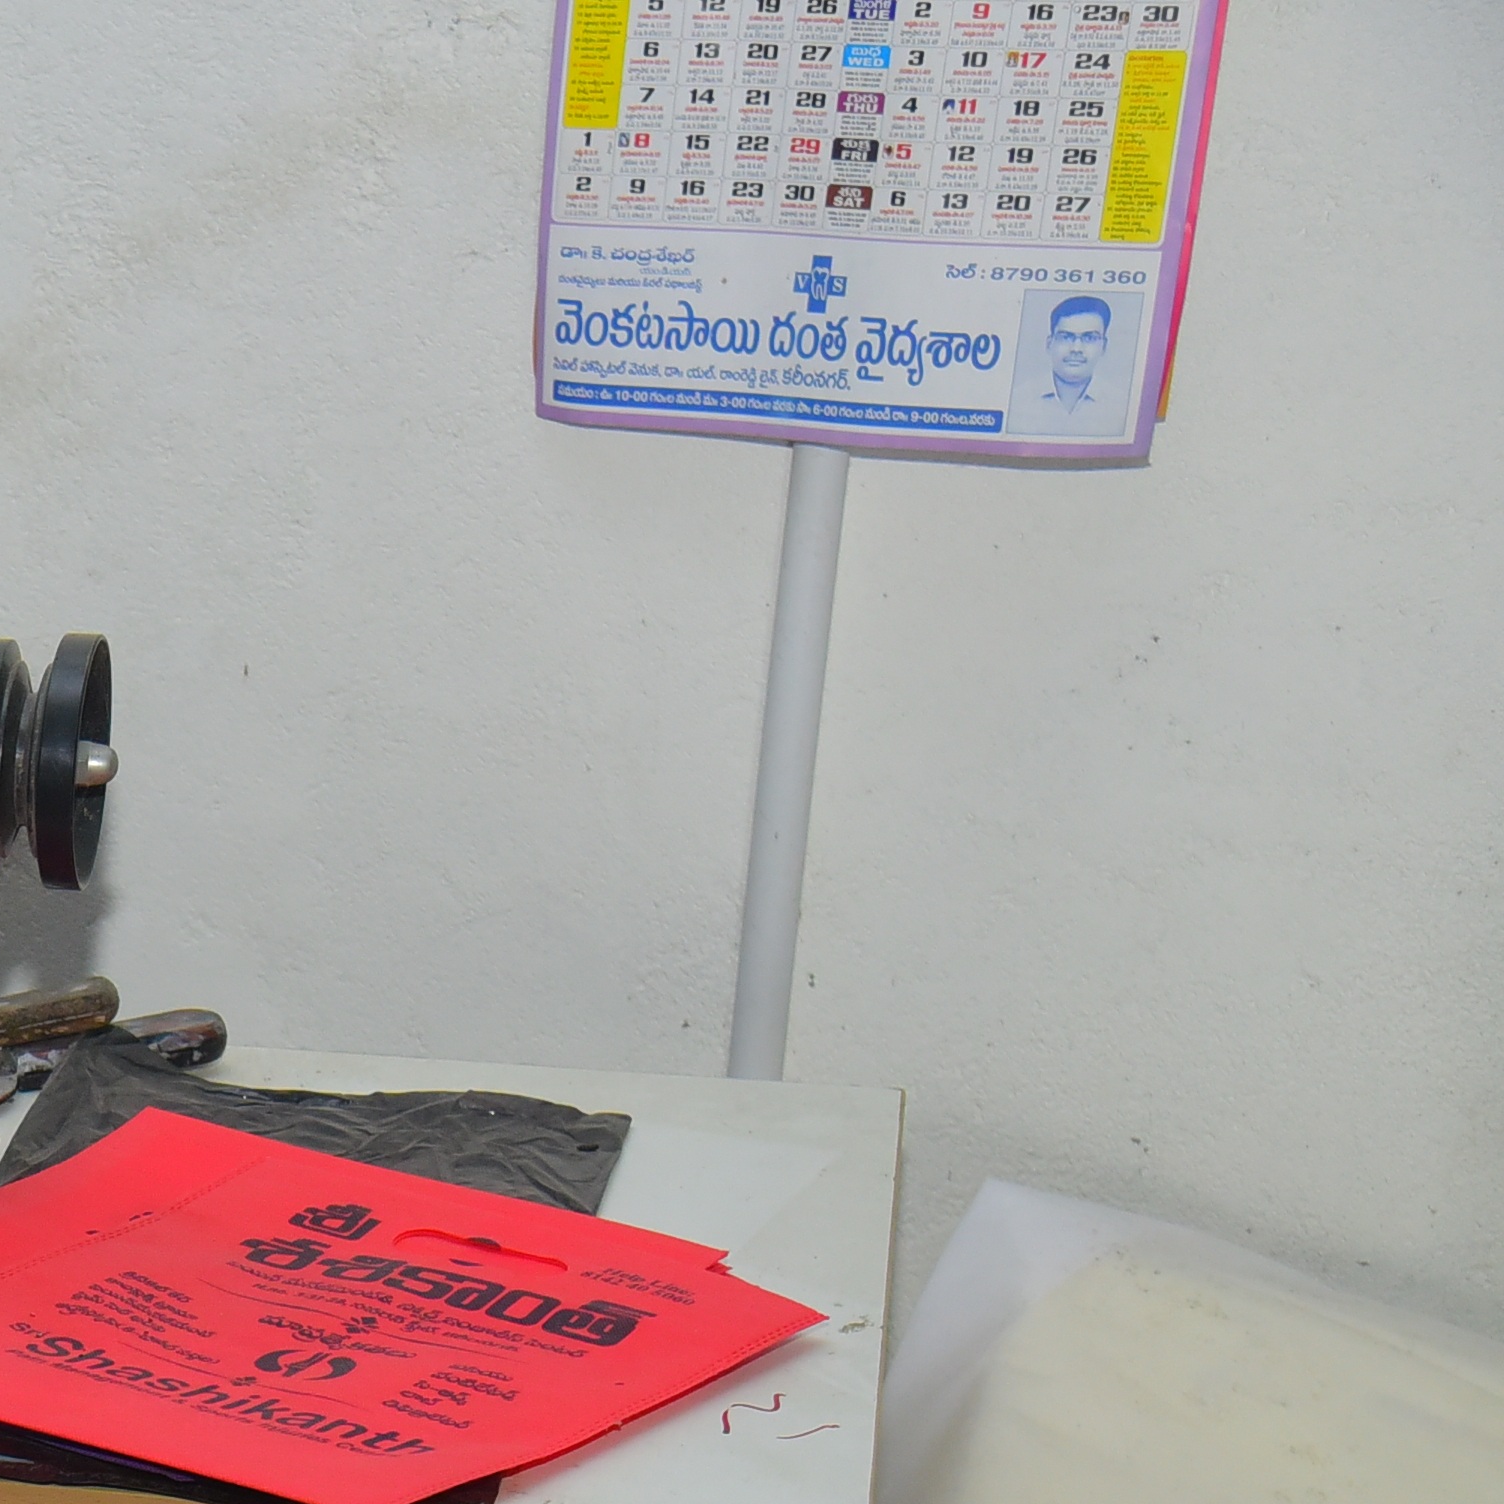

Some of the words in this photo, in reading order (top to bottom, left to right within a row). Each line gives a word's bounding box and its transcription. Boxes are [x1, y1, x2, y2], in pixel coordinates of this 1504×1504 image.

[807, 0, 838, 15] 26
[853, 9, 891, 20] TUE
[914, 2, 932, 18] 2
[972, 3, 989, 19] 9
[1027, 4, 1054, 20] 16
[1082, 6, 1118, 22] 23
[1142, 6, 1179, 22] 30
[643, 41, 660, 58] 6
[694, 42, 720, 59] 13
[747, 43, 779, 60] 20
[801, 44, 833, 62] 27
[908, 50, 925, 66] 3
[961, 52, 988, 68] 10
[1020, 53, 1047, 69] 17
[1075, 53, 1111, 70] 24
[848, 57, 885, 67] WED
[639, 87, 655, 103] 7
[689, 88, 715, 104] 14
[745, 89, 771, 106] 21
[795, 91, 827, 108] 28
[901, 97, 918, 113] 4
[958, 99, 978, 115] 11
[1014, 101, 1040, 117] 18
[1069, 102, 1105, 118] 25
[843, 102, 879, 114] THU
[583, 132, 592, 147] 1
[634, 132, 650, 149] 8
[686, 134, 710, 151] 15
[736, 135, 769, 152] 22
[790, 137, 821, 155] 29
[840, 150, 868, 161] FRI
[896, 143, 912, 160] 5
[948, 146, 975, 162] 12
[1007, 148, 1034, 164] 19
[1062, 149, 1097, 165] 26
[575, 176, 592, 192] 2
[629, 178, 646, 195] 9
[679, 180, 706, 197] 16
[731, 181, 764, 199] 23
[784, 183, 815, 201] 30
[833, 196, 865, 208] SAT
[890, 191, 906, 207] 6
[942, 193, 969, 209] 13
[996, 195, 1032, 211] 20
[1056, 196, 1092, 213] 27
[990, 267, 1048, 283] 8790
[1053, 268, 1095, 284] 361
[1103, 270, 1147, 285] 360
[555, 298, 761, 356] వెంకటసాయి
[768, 310, 849, 362] దంత
[855, 316, 1002, 386] వైద్యశాల
[615, 390, 648, 403] 10-00
[719, 394, 747, 408] 3-00
[813, 404, 838, 418] 6-00
[910, 411, 939, 425] 9-00
[8, 1321, 49, 1339] Sri
[25, 1335, 436, 1455] Shashikanth
